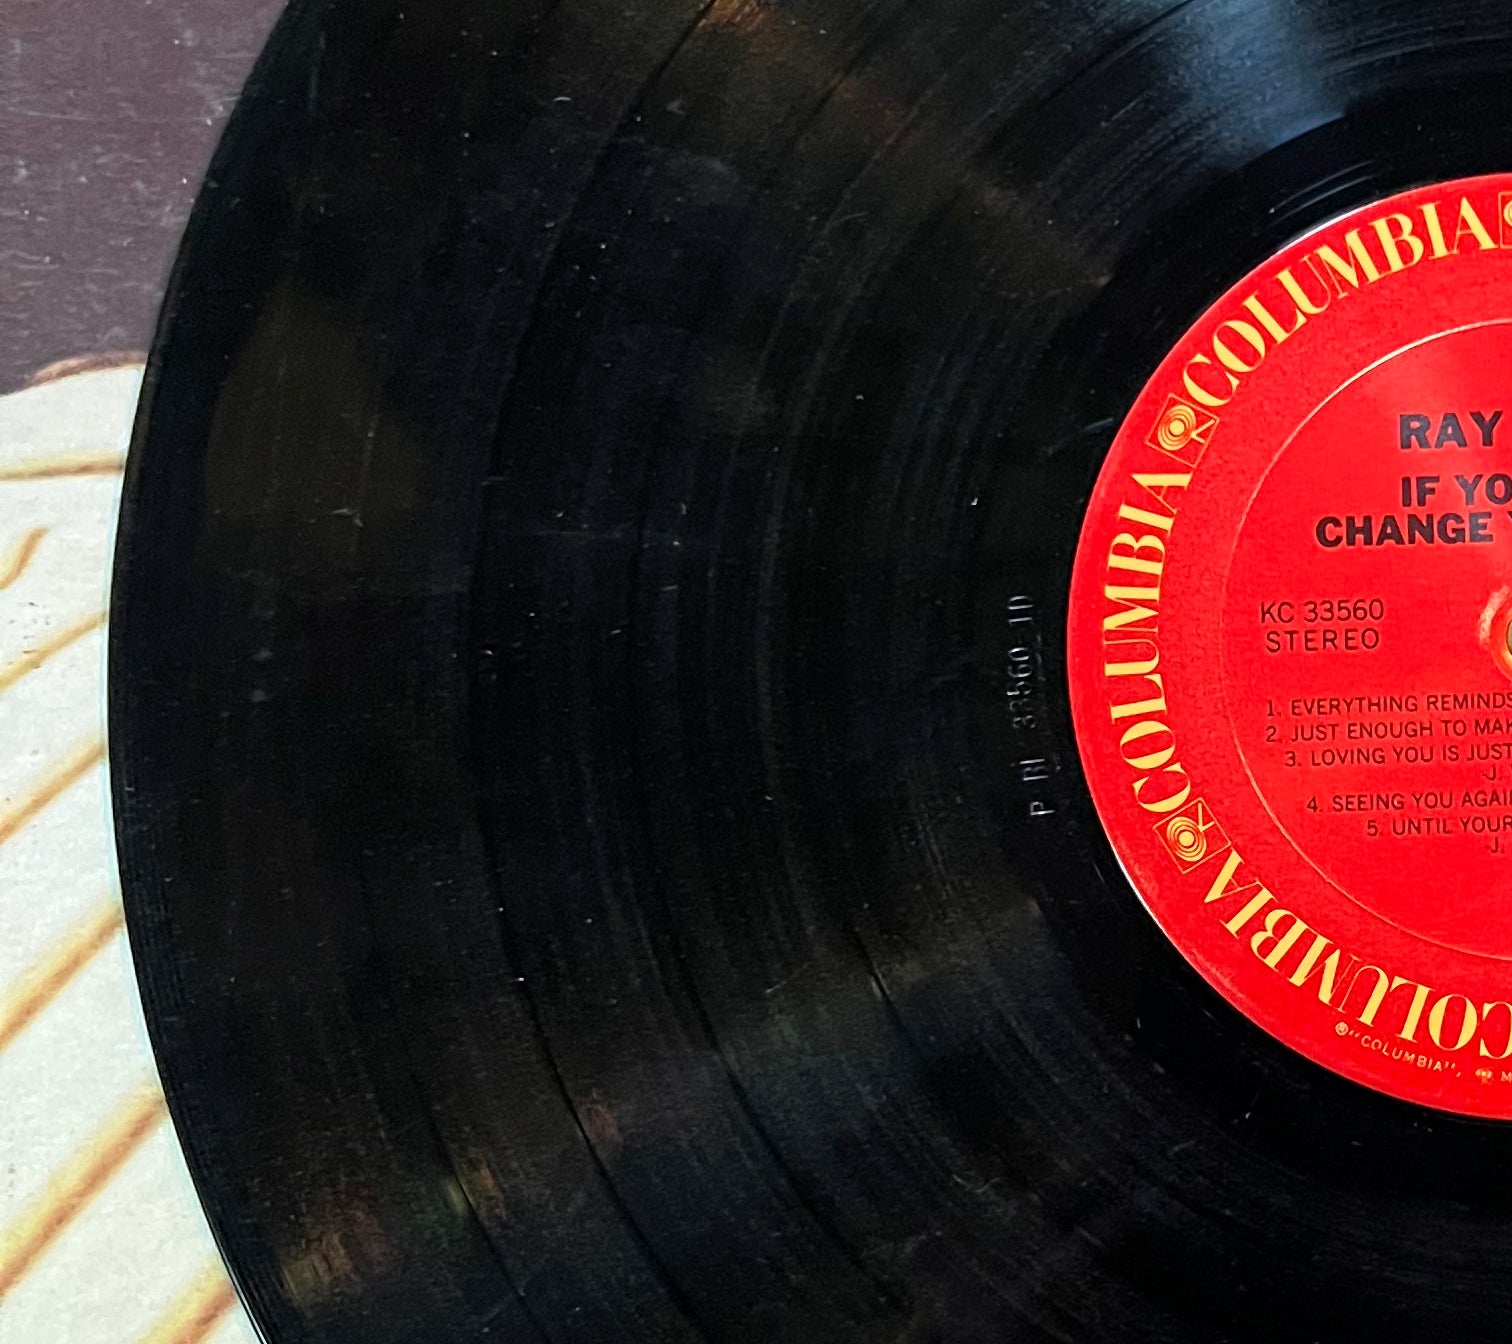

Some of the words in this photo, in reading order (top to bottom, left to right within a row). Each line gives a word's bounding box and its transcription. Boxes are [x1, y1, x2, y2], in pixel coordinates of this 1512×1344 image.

[1183, 197, 1499, 408] COLUMBIA
[1400, 411, 1503, 449] RAY
[1401, 476, 1440, 507] IF
[1315, 511, 1494, 547] CHANGE
[1260, 601, 1294, 623] KC
[1303, 598, 1384, 623] 33560
[1102, 471, 1192, 813] COLUMBIA
[1266, 627, 1379, 653] STEREO
[1266, 700, 1282, 717] 1.
[1291, 695, 1419, 716] EVERYTHING
[1265, 725, 1282, 743] 2.
[1290, 723, 1339, 743] JUST
[1348, 721, 1433, 739] ENOUGH
[1441, 719, 1467, 737] TO
[1284, 750, 1302, 767] 3.
[1311, 747, 1386, 767] LOVING
[1392, 746, 1434, 763] YOU
[1442, 744, 1459, 762] IS
[1306, 796, 1324, 813] 4.
[1332, 793, 1405, 812] SEEING
[1411, 791, 1453, 809] YOU
[1366, 819, 1385, 837] 5.
[1392, 817, 1453, 836] UNTIL
